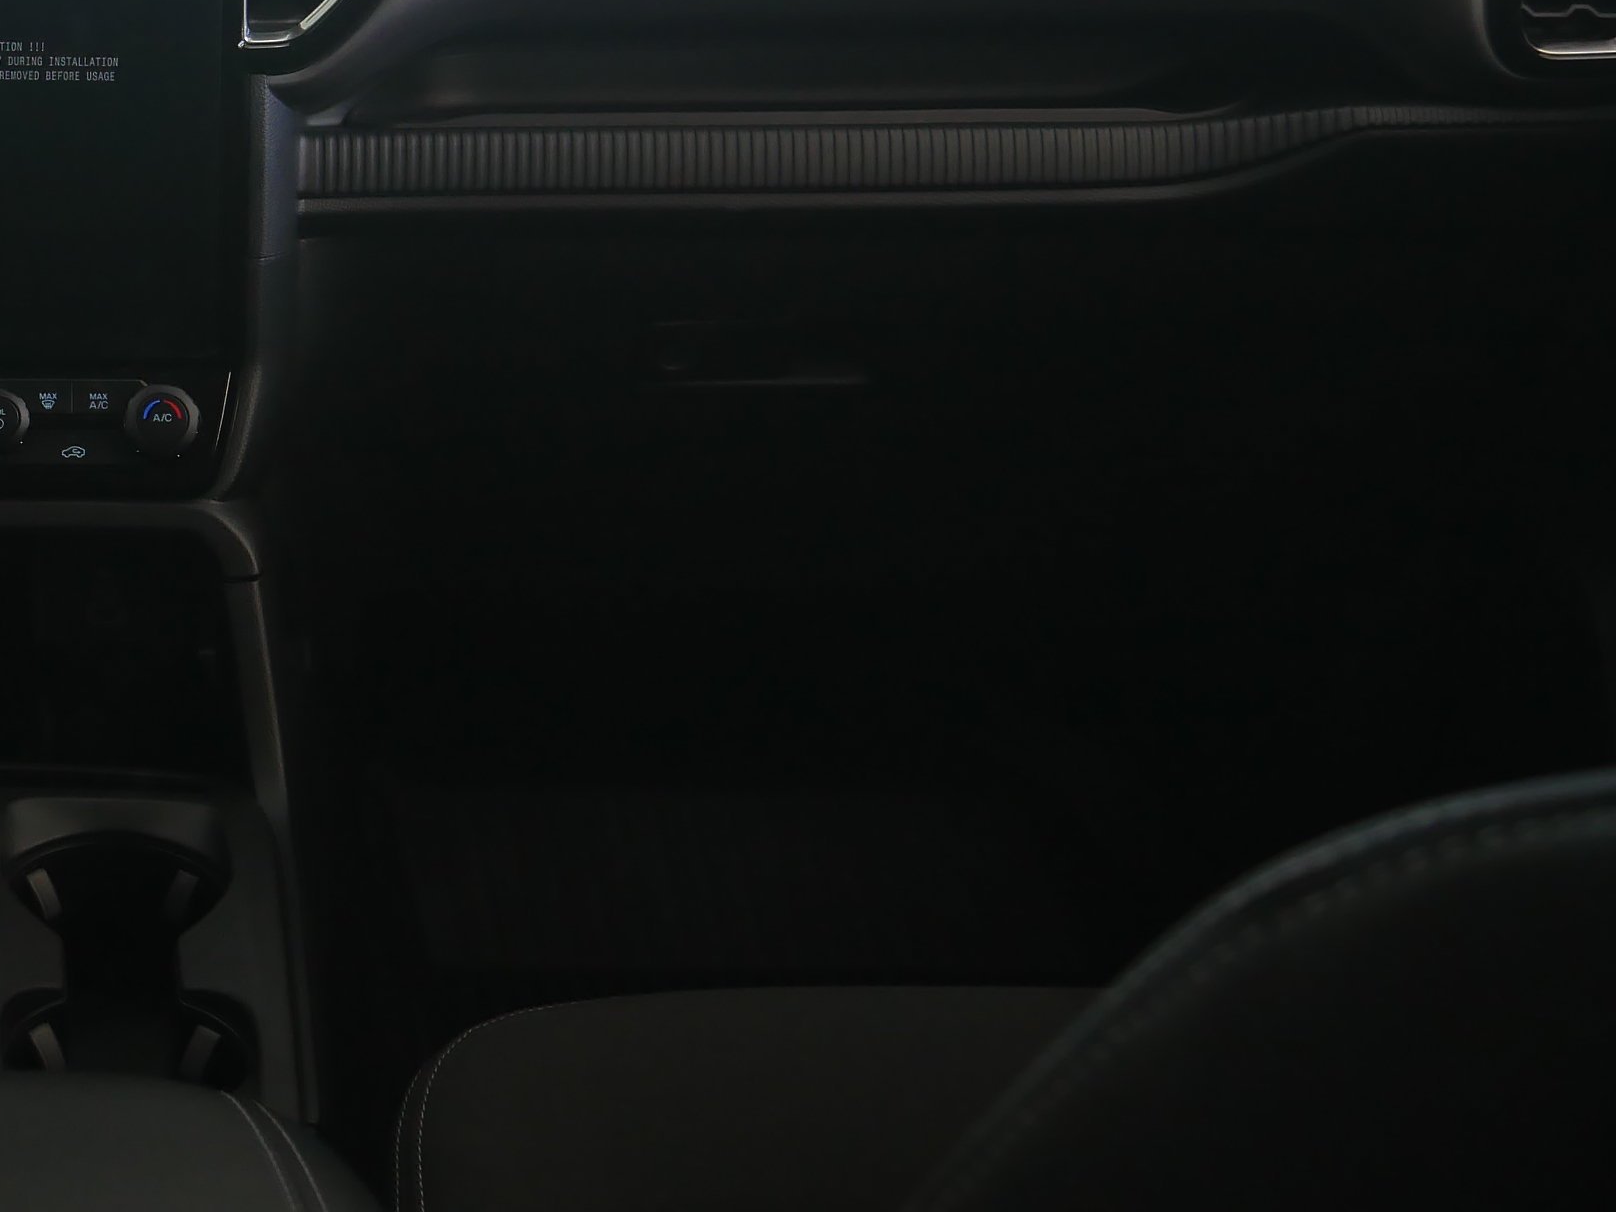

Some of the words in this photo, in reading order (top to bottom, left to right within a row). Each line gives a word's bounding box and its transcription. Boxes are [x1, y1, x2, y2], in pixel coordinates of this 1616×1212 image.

[7, 56, 43, 67] DURING
[49, 57, 119, 67] INSTALLATION
[0, 70, 40, 81] REMOVED
[45, 71, 81, 81] BEFORE
[86, 71, 116, 82] USAGE
[89, 400, 109, 410] A/C
[153, 413, 173, 423] A/C
